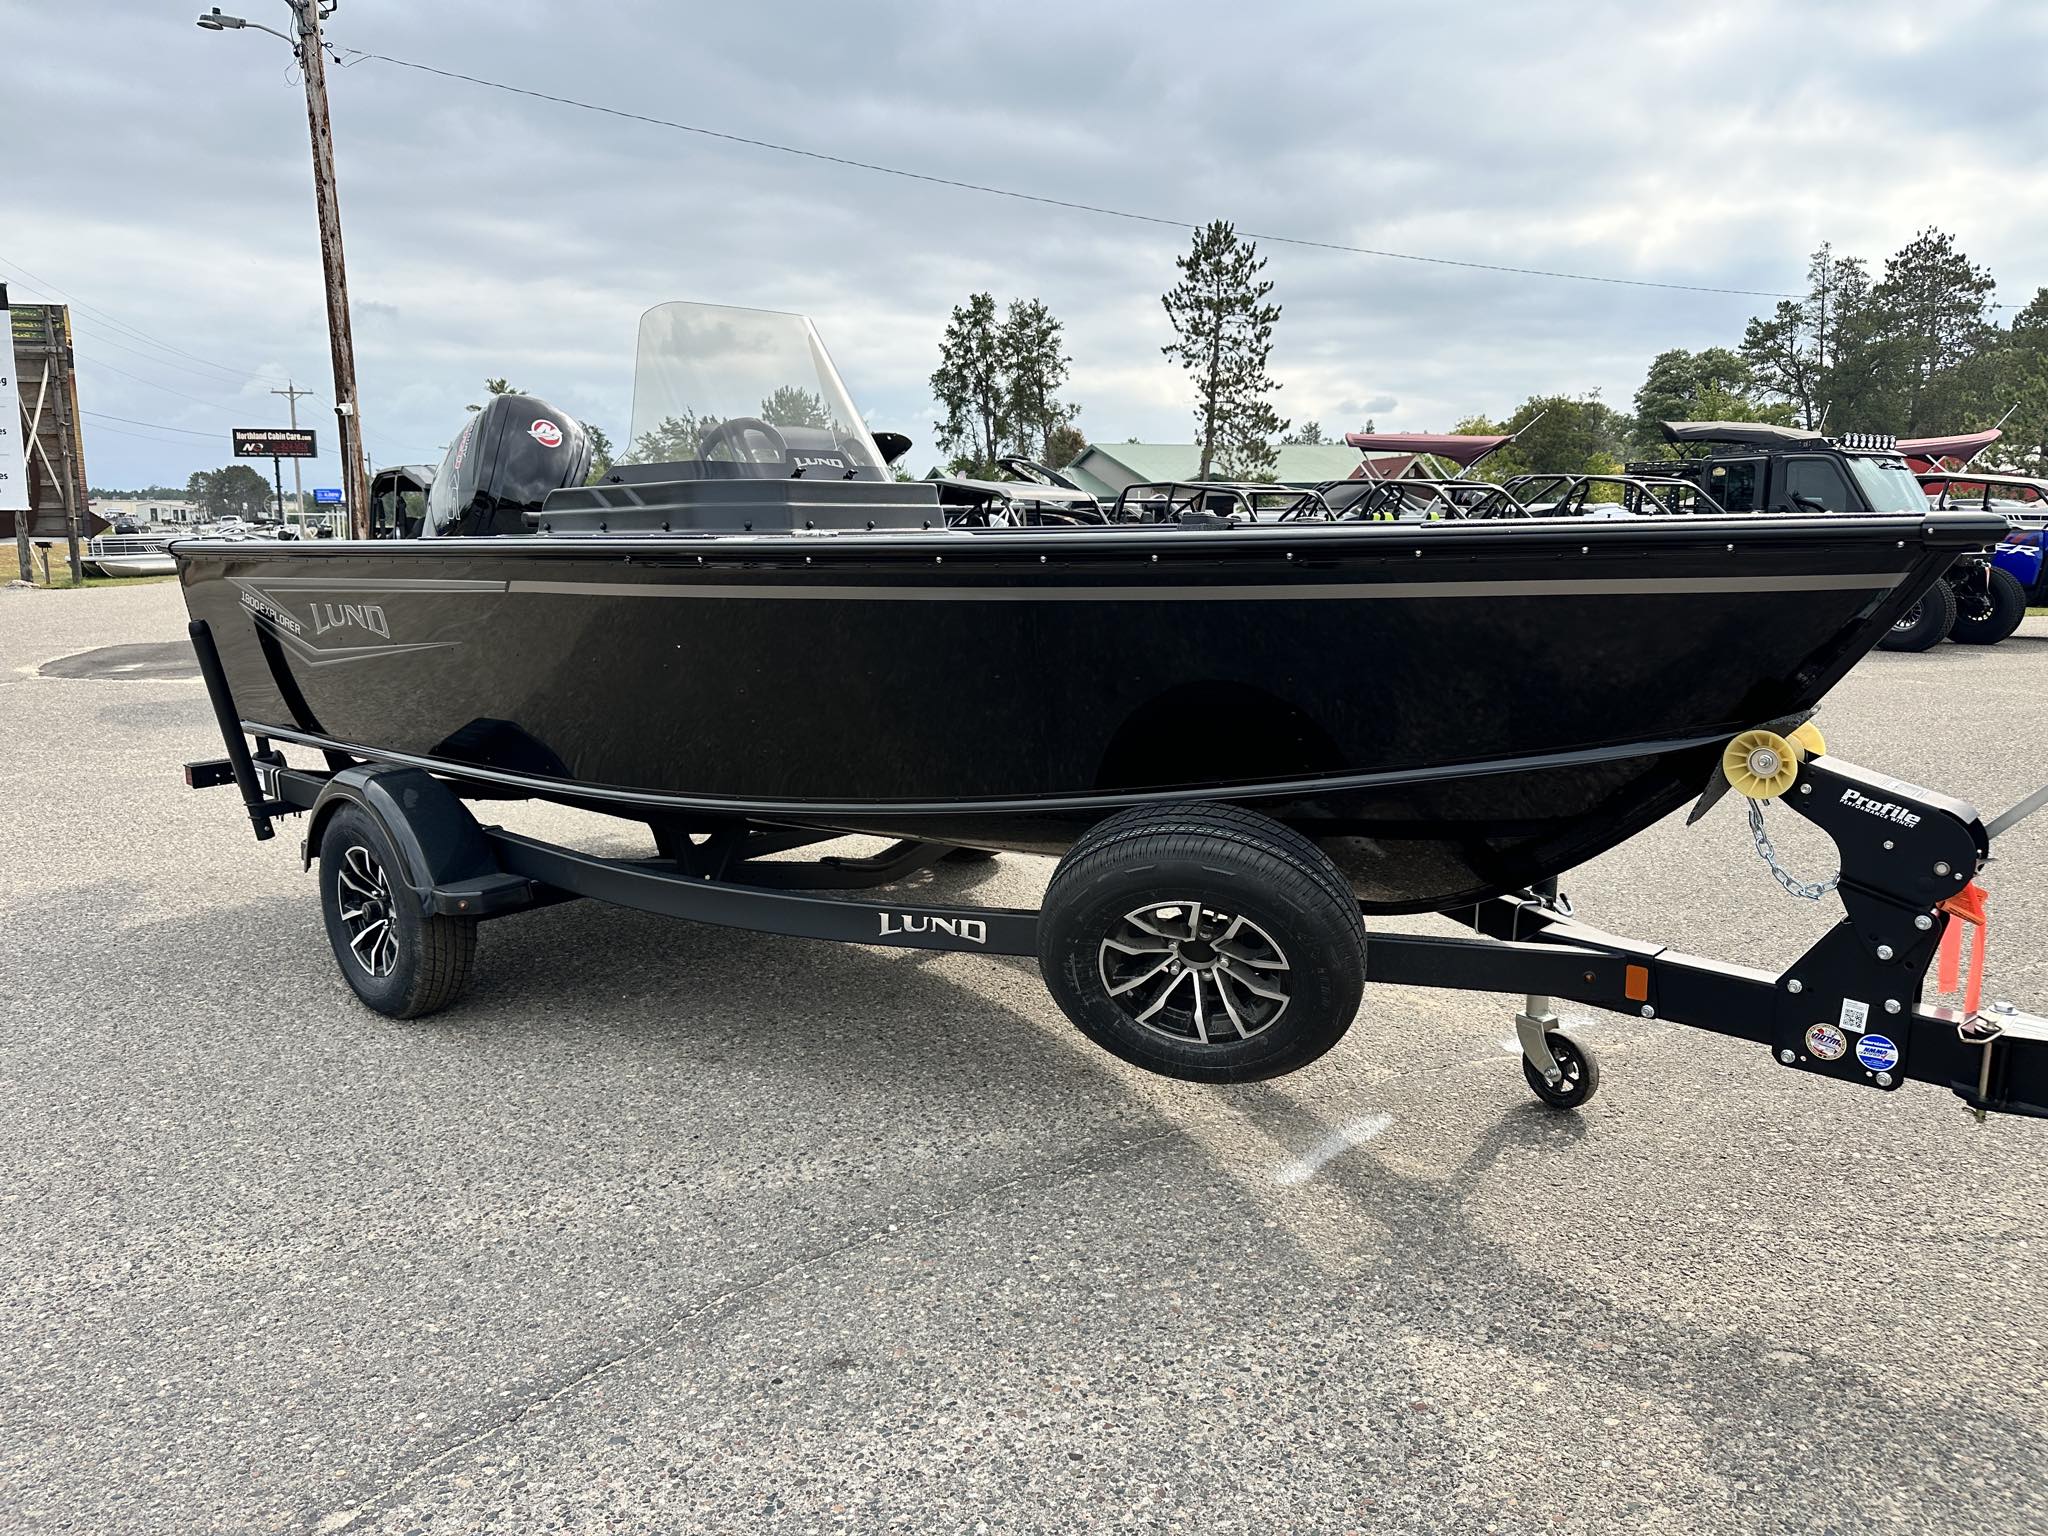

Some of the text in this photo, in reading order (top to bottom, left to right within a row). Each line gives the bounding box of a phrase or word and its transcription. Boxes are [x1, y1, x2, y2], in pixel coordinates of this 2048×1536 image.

[236, 431, 267, 440] Northland
[793, 457, 845, 469] LUND
[310, 603, 390, 639] LUND
[1840, 798, 1916, 829] PERFORMANCE WINCH
[1841, 788, 1921, 825] Profile
[878, 912, 987, 944] LUND
